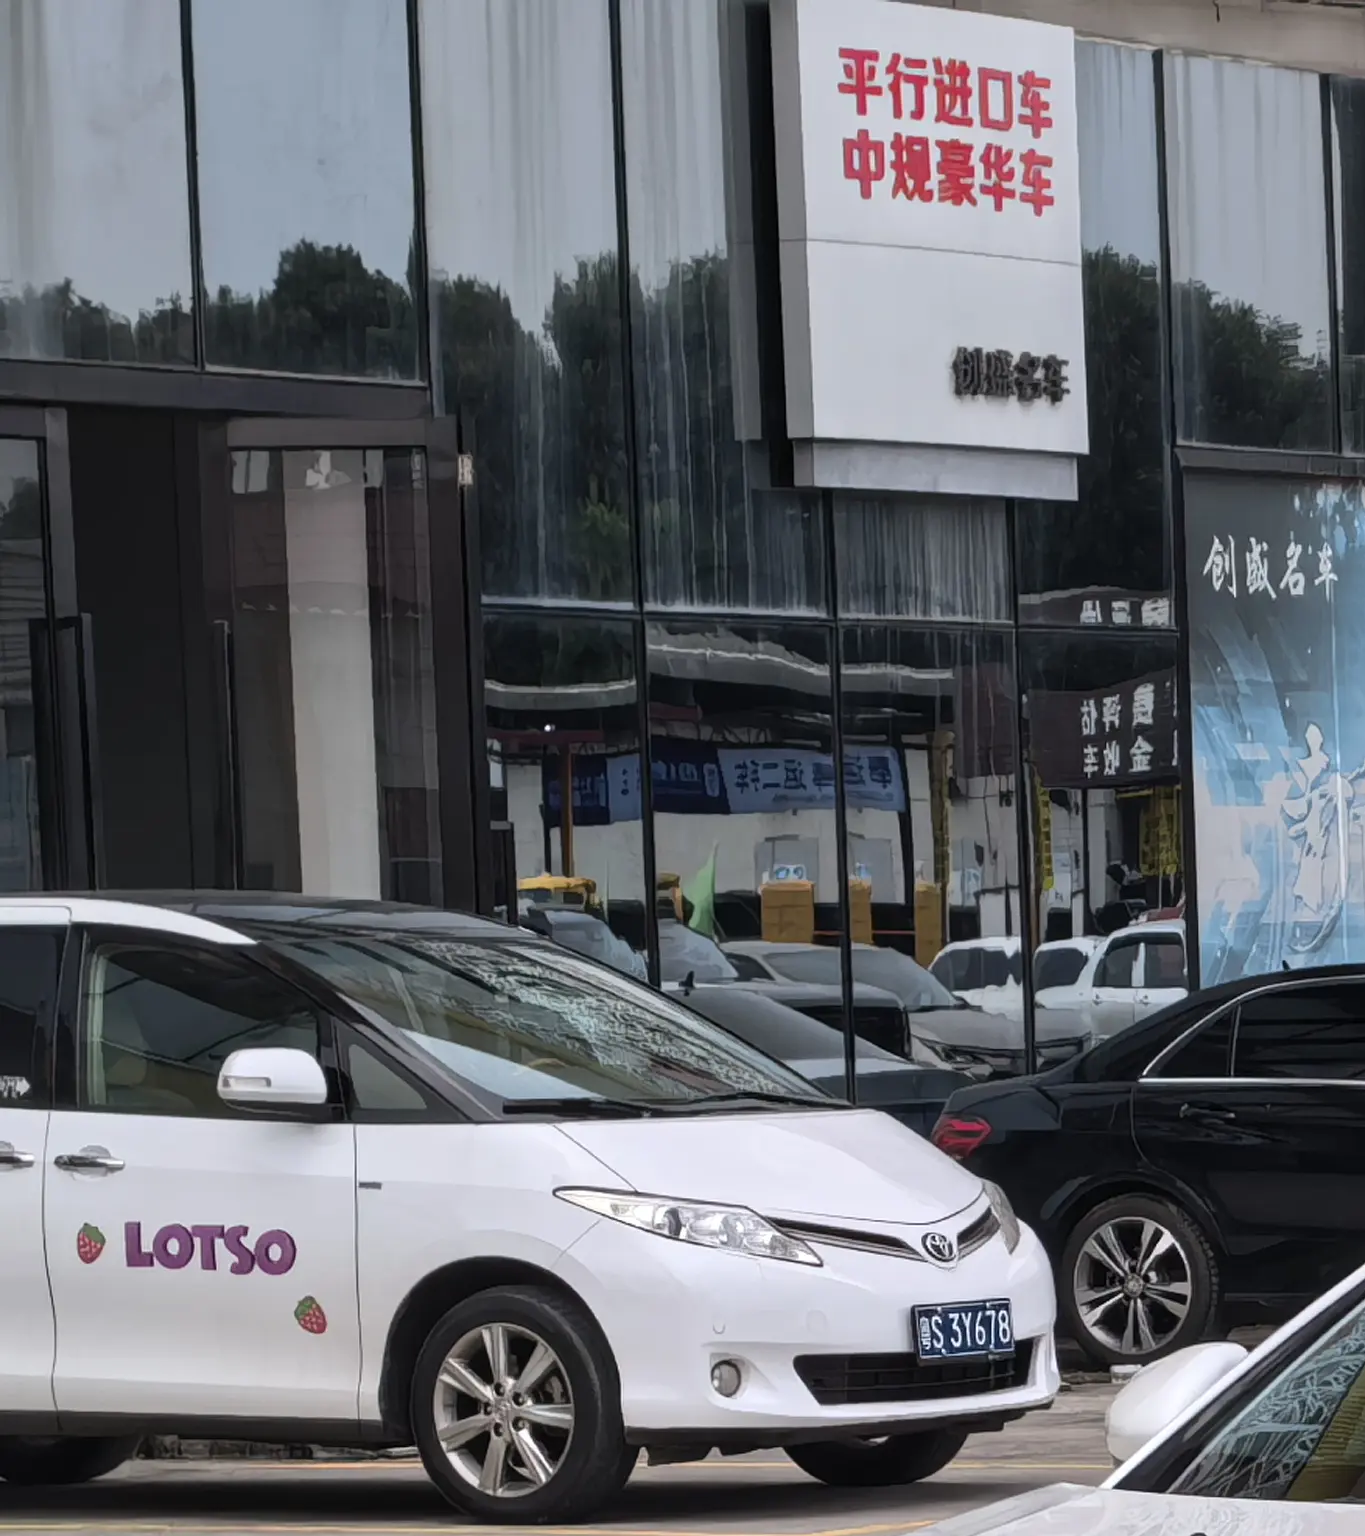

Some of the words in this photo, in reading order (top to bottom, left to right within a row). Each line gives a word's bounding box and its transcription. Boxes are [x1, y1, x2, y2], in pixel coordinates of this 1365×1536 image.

[837, 47, 1053, 139] 平行进口车
[842, 129, 1055, 217] 中规豪华车
[125, 1221, 297, 1276] LOTSO
